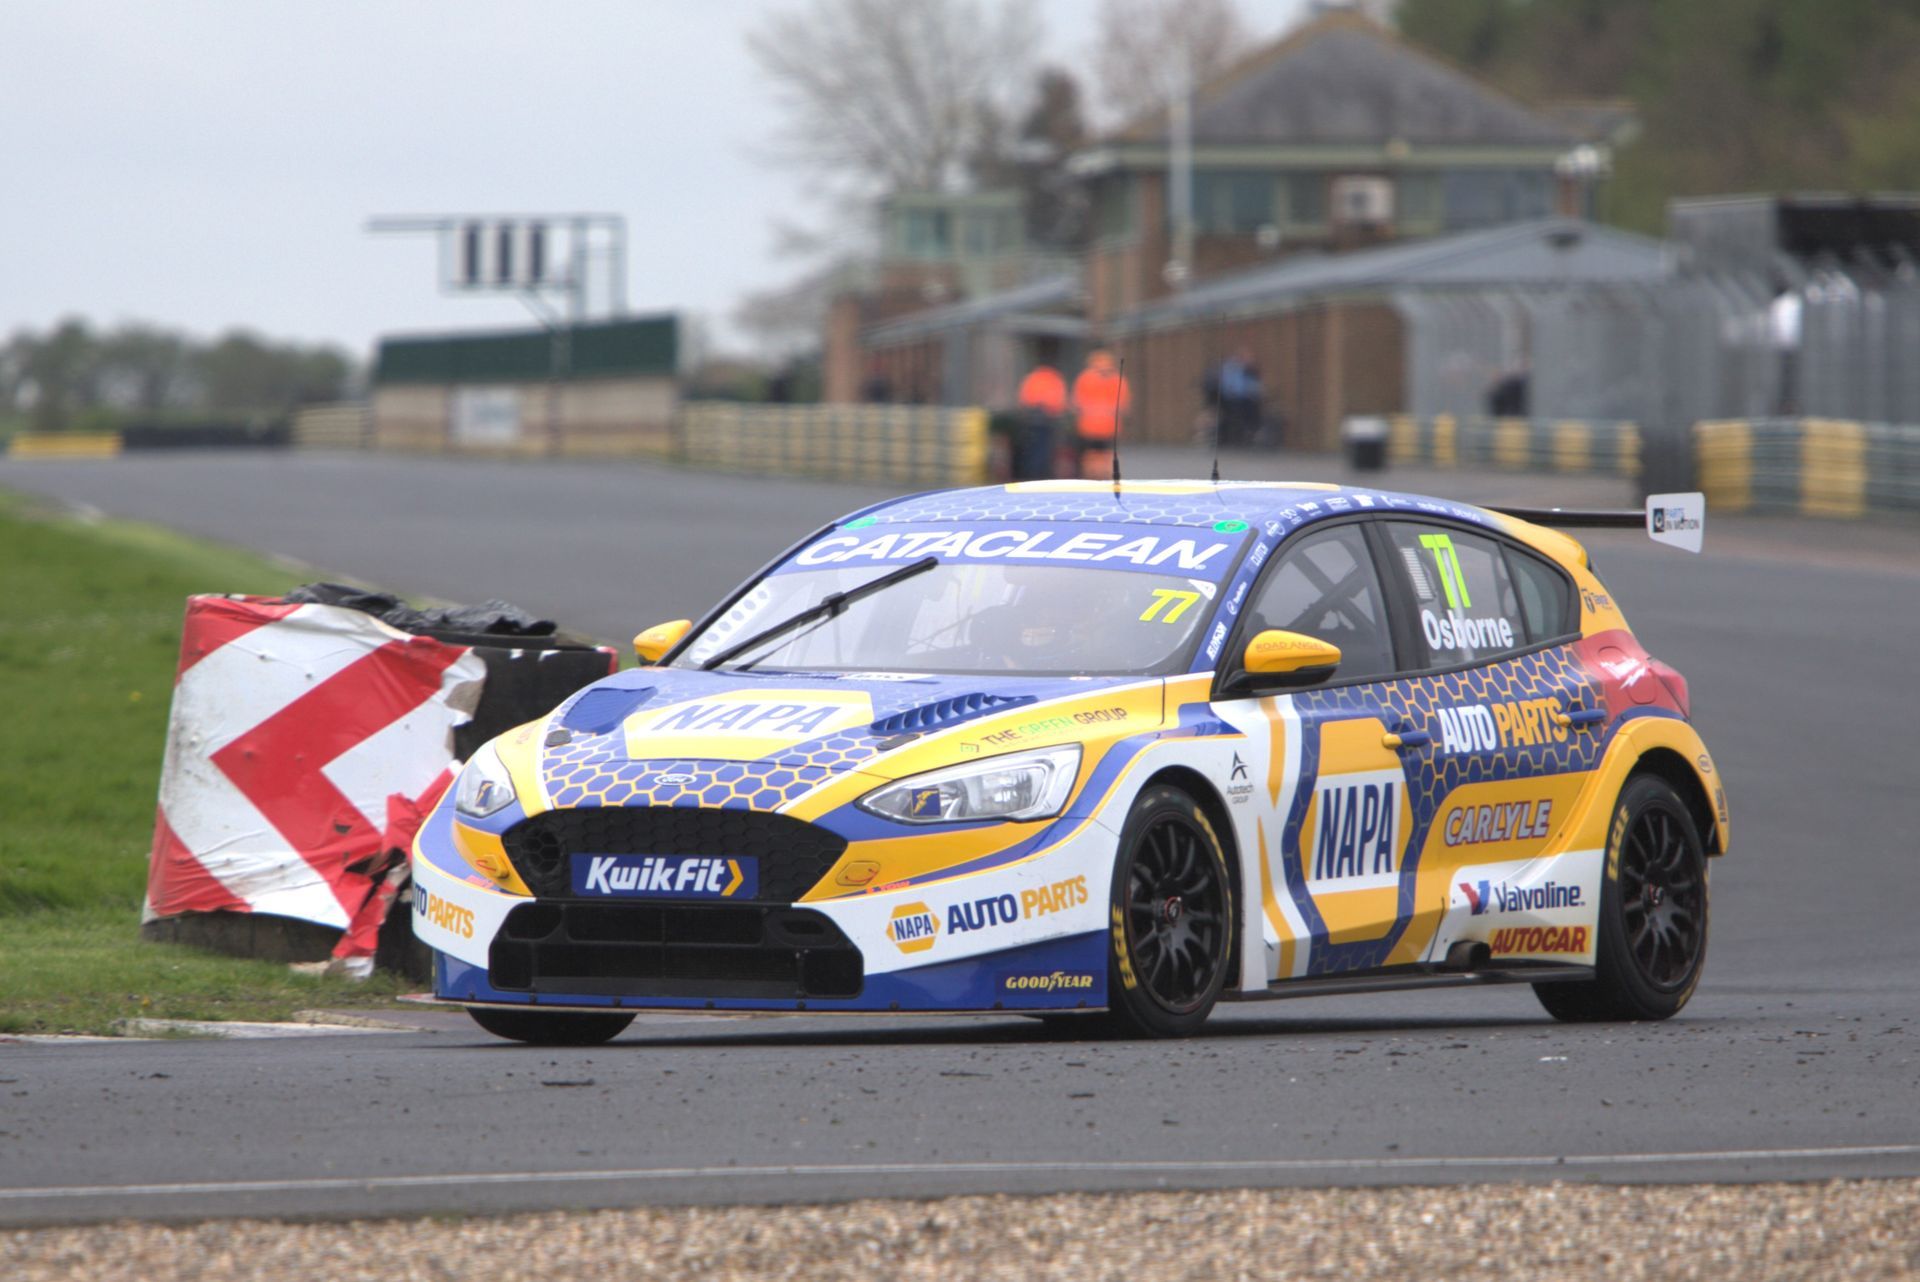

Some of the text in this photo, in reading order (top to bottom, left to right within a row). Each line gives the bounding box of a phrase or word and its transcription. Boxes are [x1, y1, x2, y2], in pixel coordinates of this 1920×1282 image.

[796, 530, 1228, 569] CATACLEAN
[1419, 534, 1472, 609] 77
[1139, 588, 1201, 624] 77
[1421, 609, 1514, 650] Osborne
[651, 704, 841, 734] NAPA
[981, 707, 1128, 745] THE GREEN GROUP
[1437, 696, 1568, 754] AUTO PARTS
[1315, 782, 1395, 881] NAPA
[1444, 799, 1553, 847] CARLYLE
[428, 893, 475, 939] PARTS
[893, 875, 1088, 940] NAPA AUTO PARTS
[1494, 881, 1581, 913] Valvoline
[1491, 926, 1586, 954] AUTOCAR
[1005, 971, 1094, 992] GOODYEAR
